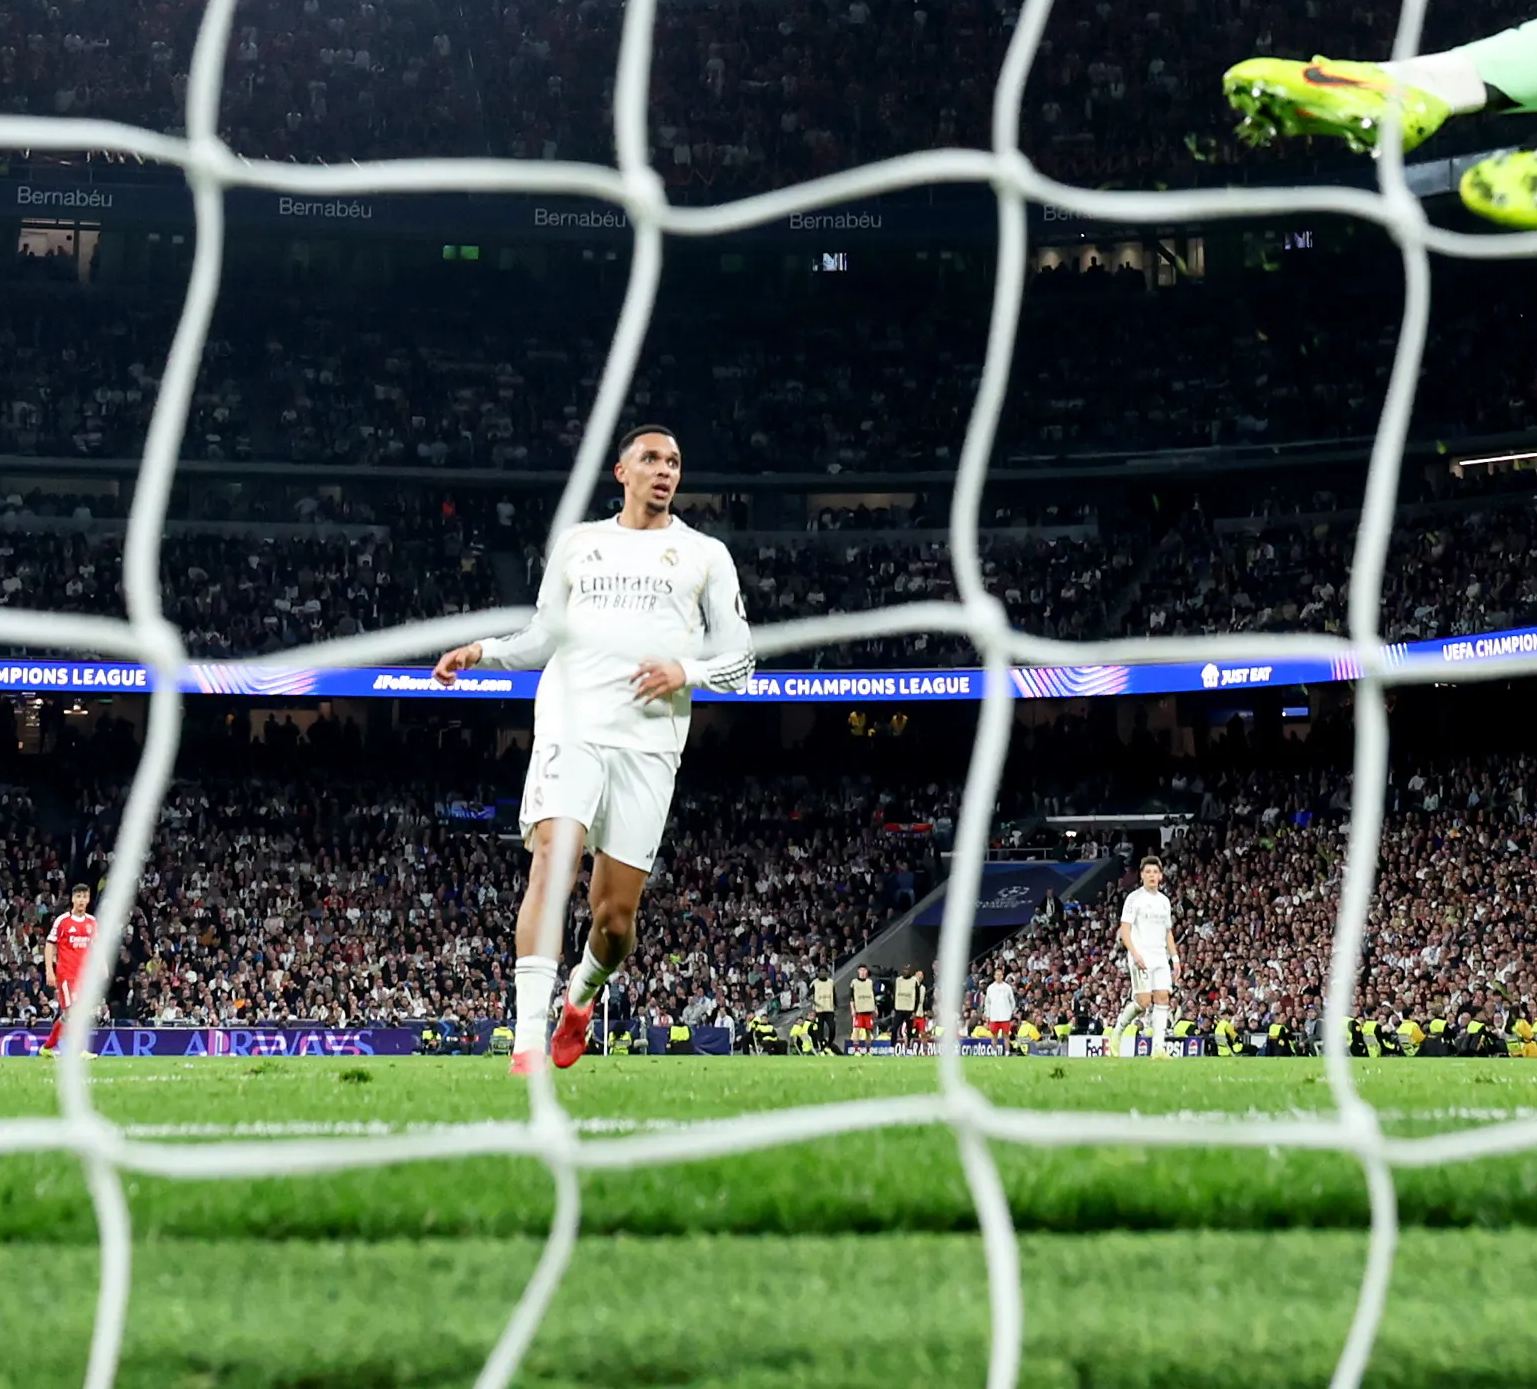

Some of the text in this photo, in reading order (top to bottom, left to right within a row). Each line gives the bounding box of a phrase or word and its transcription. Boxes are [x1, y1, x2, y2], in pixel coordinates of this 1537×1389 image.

[17, 185, 113, 209] Bernabéu
[279, 197, 373, 220] Bernabéu
[533, 208, 627, 229] Bernabéu
[789, 212, 882, 231] Bernabéu
[580, 573, 674, 595] Emirates
[614, 594, 657, 611] BETTER
[1442, 641, 1475, 663] UEFA
[72, 667, 147, 687] LEAGUE
[784, 677, 895, 696] CHAMPIONS
[899, 676, 970, 695] LEAGUE
[1221, 666, 1272, 686] JUST EAT
[0, 1030, 158, 1057] QAR
[1086, 1038, 1110, 1057] FedE
[1163, 1040, 1184, 1057] PSI
